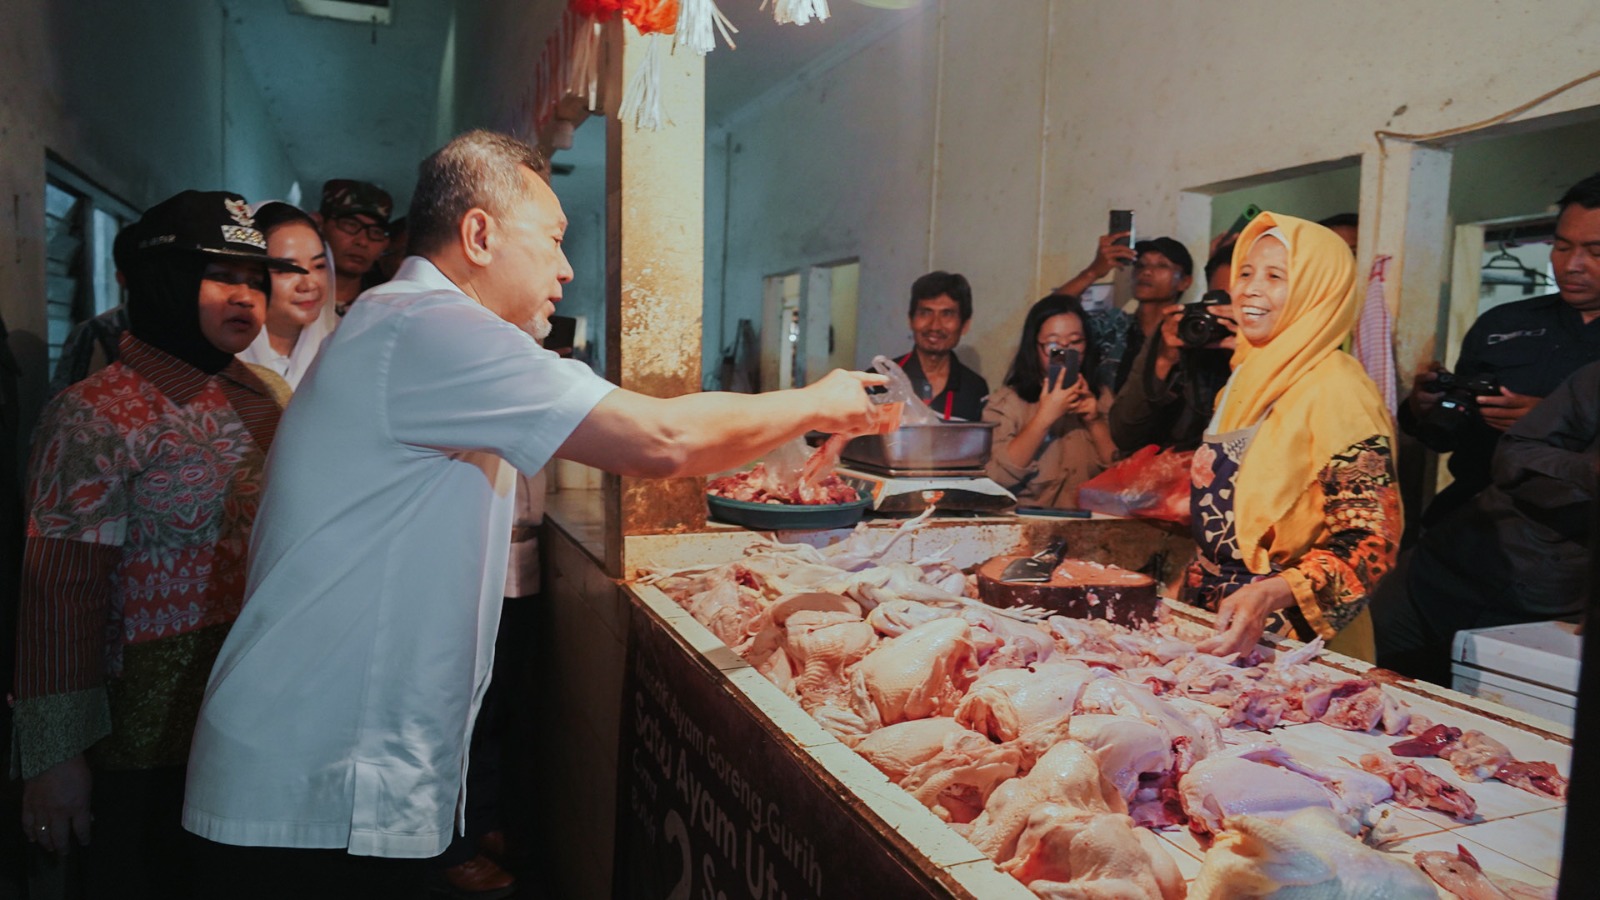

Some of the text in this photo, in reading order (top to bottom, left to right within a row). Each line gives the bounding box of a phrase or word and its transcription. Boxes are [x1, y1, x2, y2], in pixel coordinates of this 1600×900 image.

[635, 691, 672, 779] Satu
[676, 747, 737, 869] Ayam
[745, 829, 788, 900] Ut
[663, 808, 692, 900] 2
[669, 692, 704, 755] Ayam
[706, 735, 762, 834] Goreng
[766, 802, 822, 897] Gurih
